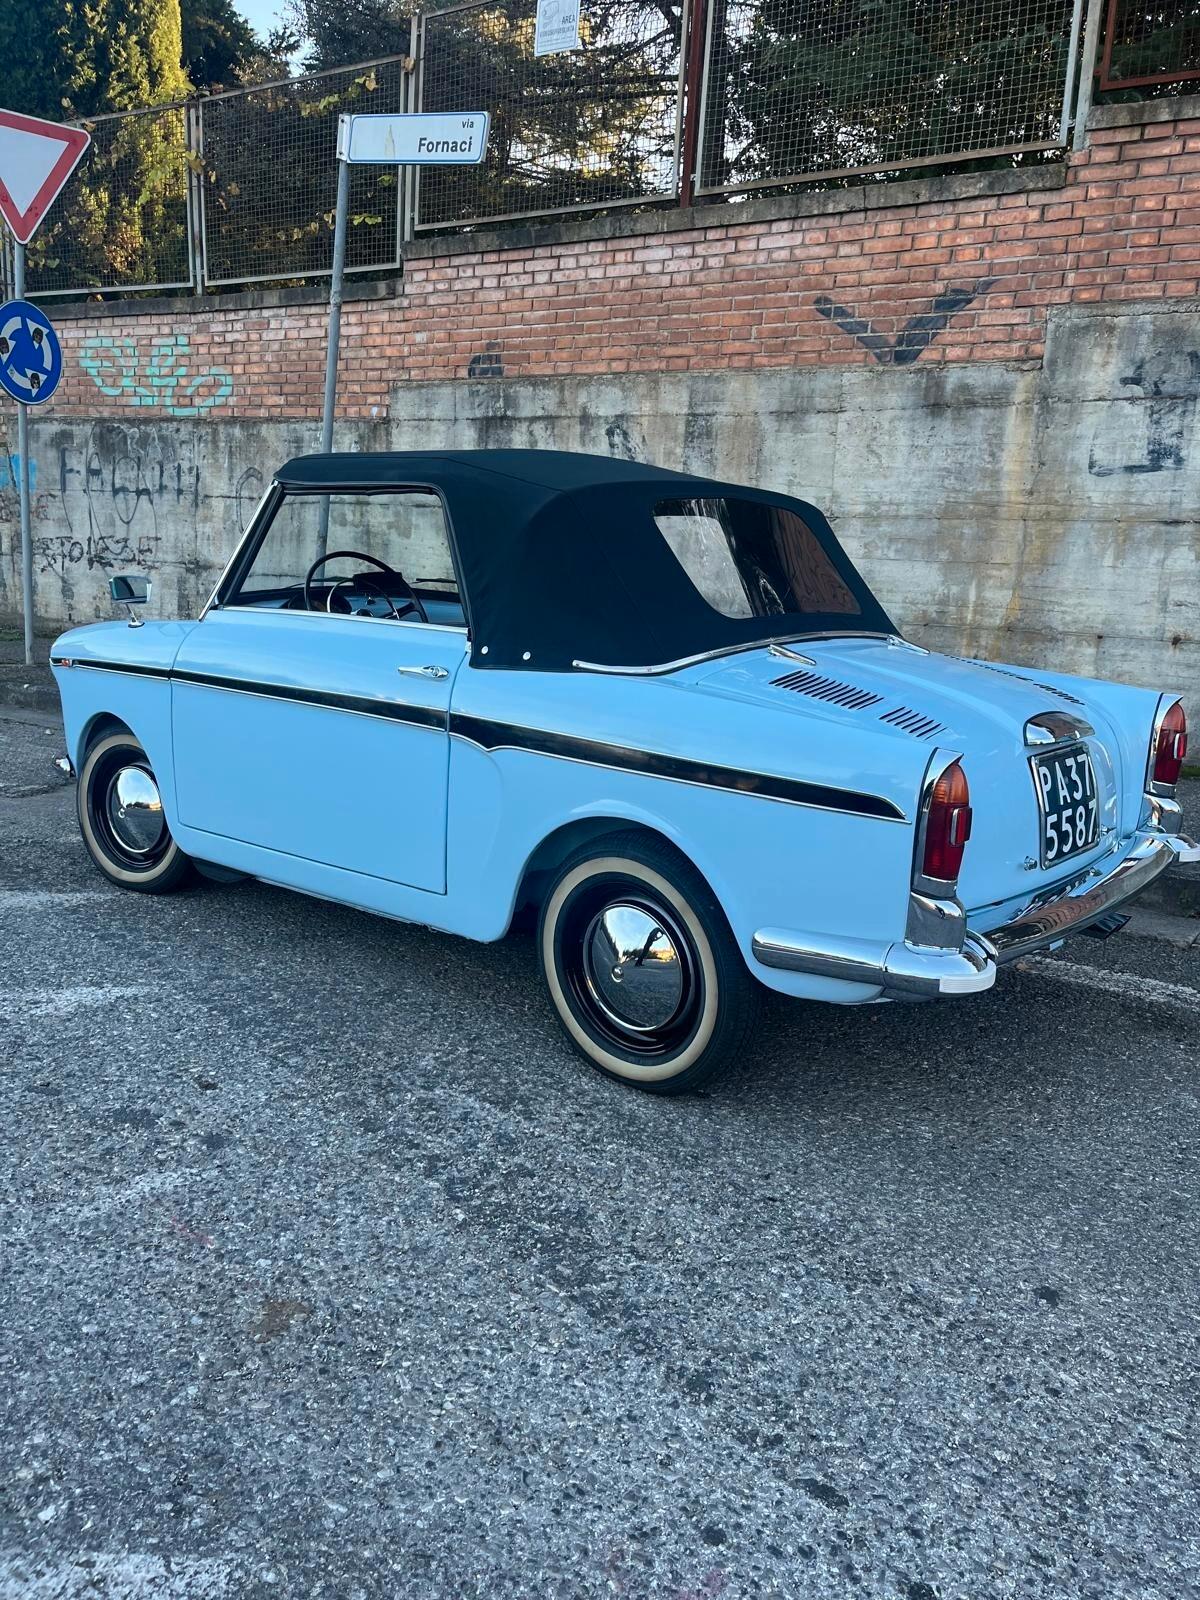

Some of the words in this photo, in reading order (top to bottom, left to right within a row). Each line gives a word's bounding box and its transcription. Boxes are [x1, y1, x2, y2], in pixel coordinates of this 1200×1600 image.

[561, 14, 576, 25] AREA
[461, 118, 474, 128] via
[418, 136, 473, 153] Fornaci
[1038, 753, 1091, 813] PA37
[1046, 798, 1097, 860] 5587
